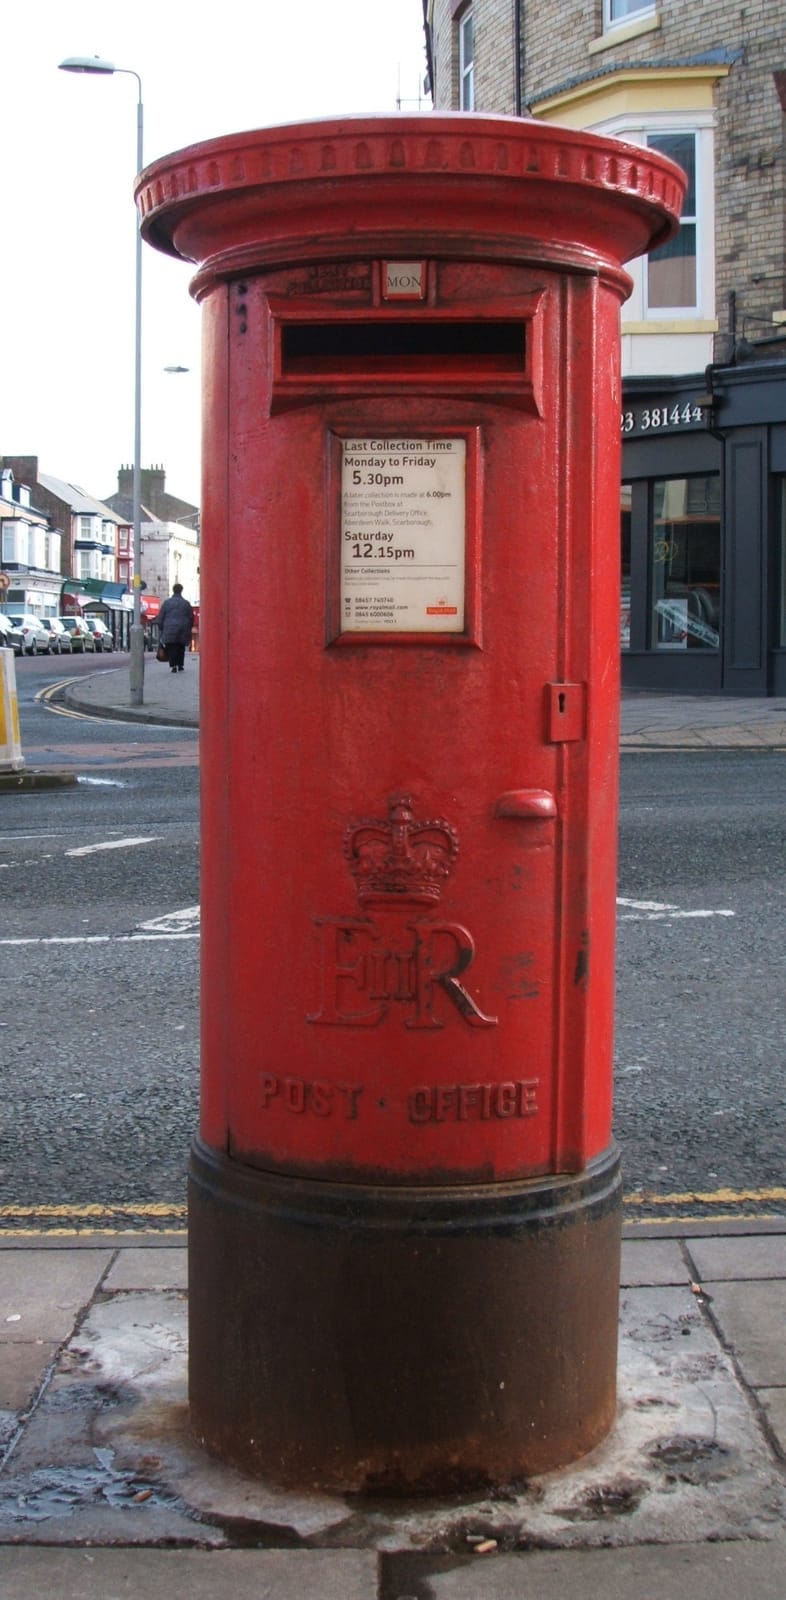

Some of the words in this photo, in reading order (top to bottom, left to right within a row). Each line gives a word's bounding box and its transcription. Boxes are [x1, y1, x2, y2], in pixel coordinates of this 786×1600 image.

[387, 276, 422, 288] MON
[640, 402, 703, 431] 381444
[344, 441, 367, 451] Last
[370, 440, 423, 451] Collection
[425, 440, 452, 450] Time
[344, 458, 387, 468] Monday
[388, 458, 400, 466] to
[402, 456, 437, 468] Friday
[352, 470, 404, 487] 5.30pm
[426, 491, 452, 499] 6.00pm
[344, 530, 394, 542] Saturday
[352, 543, 415, 560] 12.15pm
[260, 1070, 363, 1121] POST
[408, 1077, 540, 1124] OFFICE
